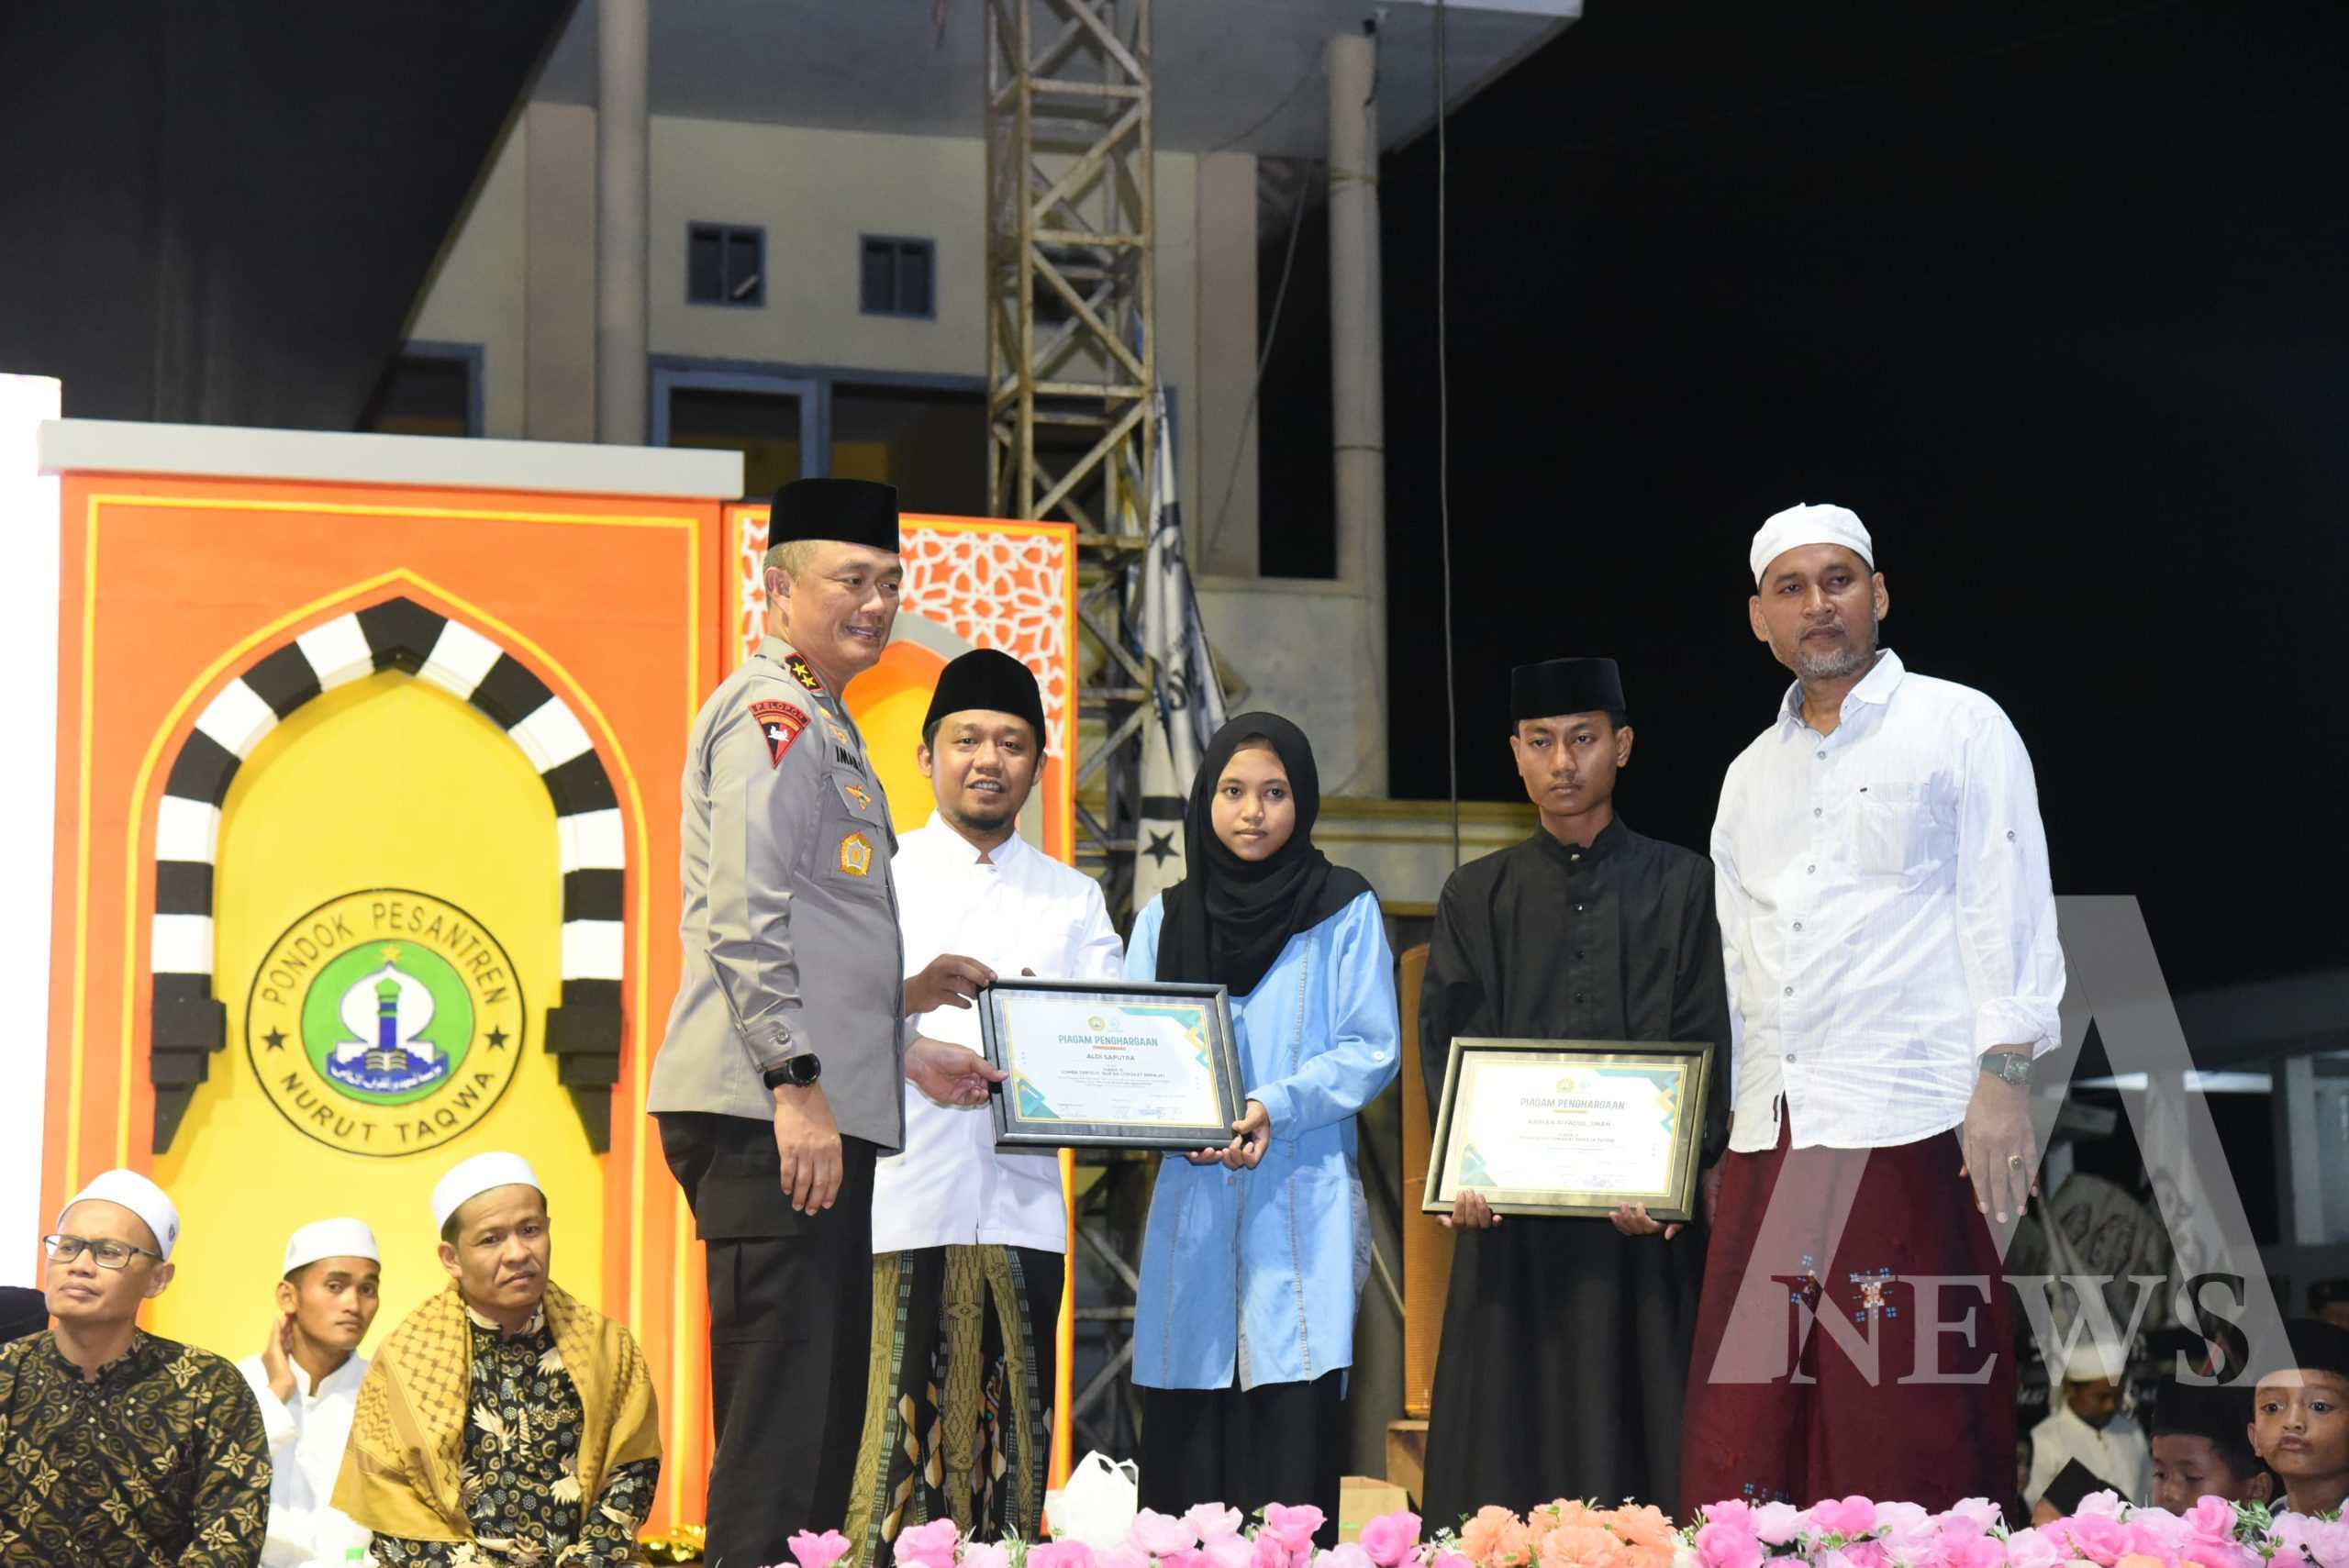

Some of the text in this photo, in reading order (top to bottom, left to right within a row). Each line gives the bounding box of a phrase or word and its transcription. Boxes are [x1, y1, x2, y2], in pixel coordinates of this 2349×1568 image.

[262, 902, 507, 1006] PONDOK PESANTREN
[1058, 1034, 1158, 1047] PIAGAM PENGHARGAAN
[280, 1071, 495, 1142] NURUT TAQWA
